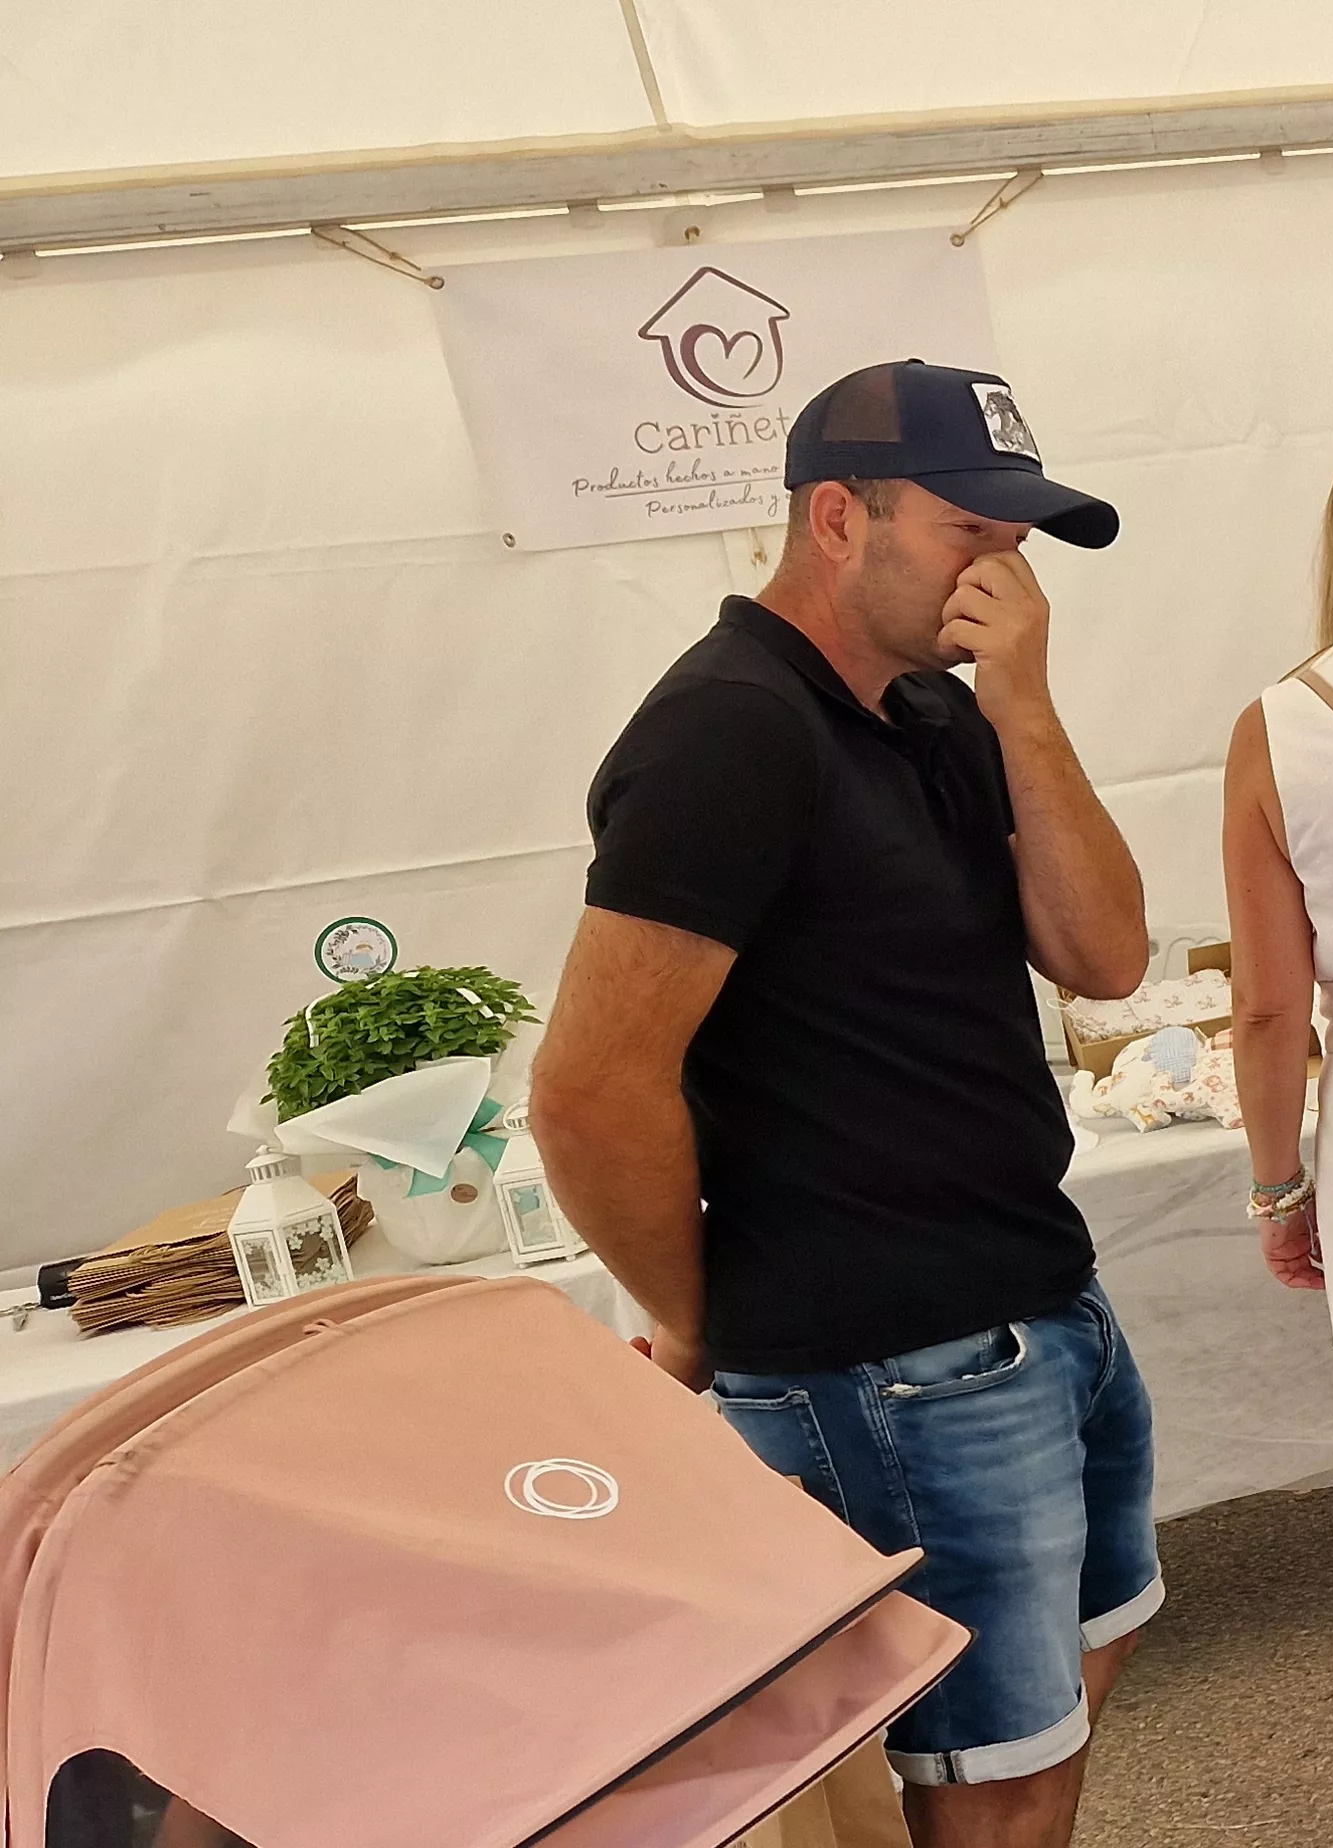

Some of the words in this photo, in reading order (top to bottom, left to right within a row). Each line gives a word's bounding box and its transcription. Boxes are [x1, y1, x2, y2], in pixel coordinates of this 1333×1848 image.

[571, 467, 659, 497] Productos
[666, 458, 717, 484] hechos
[723, 469, 735, 478] a
[740, 465, 780, 477] mano
[645, 483, 763, 518] Personalizados
[767, 494, 781, 518] y
